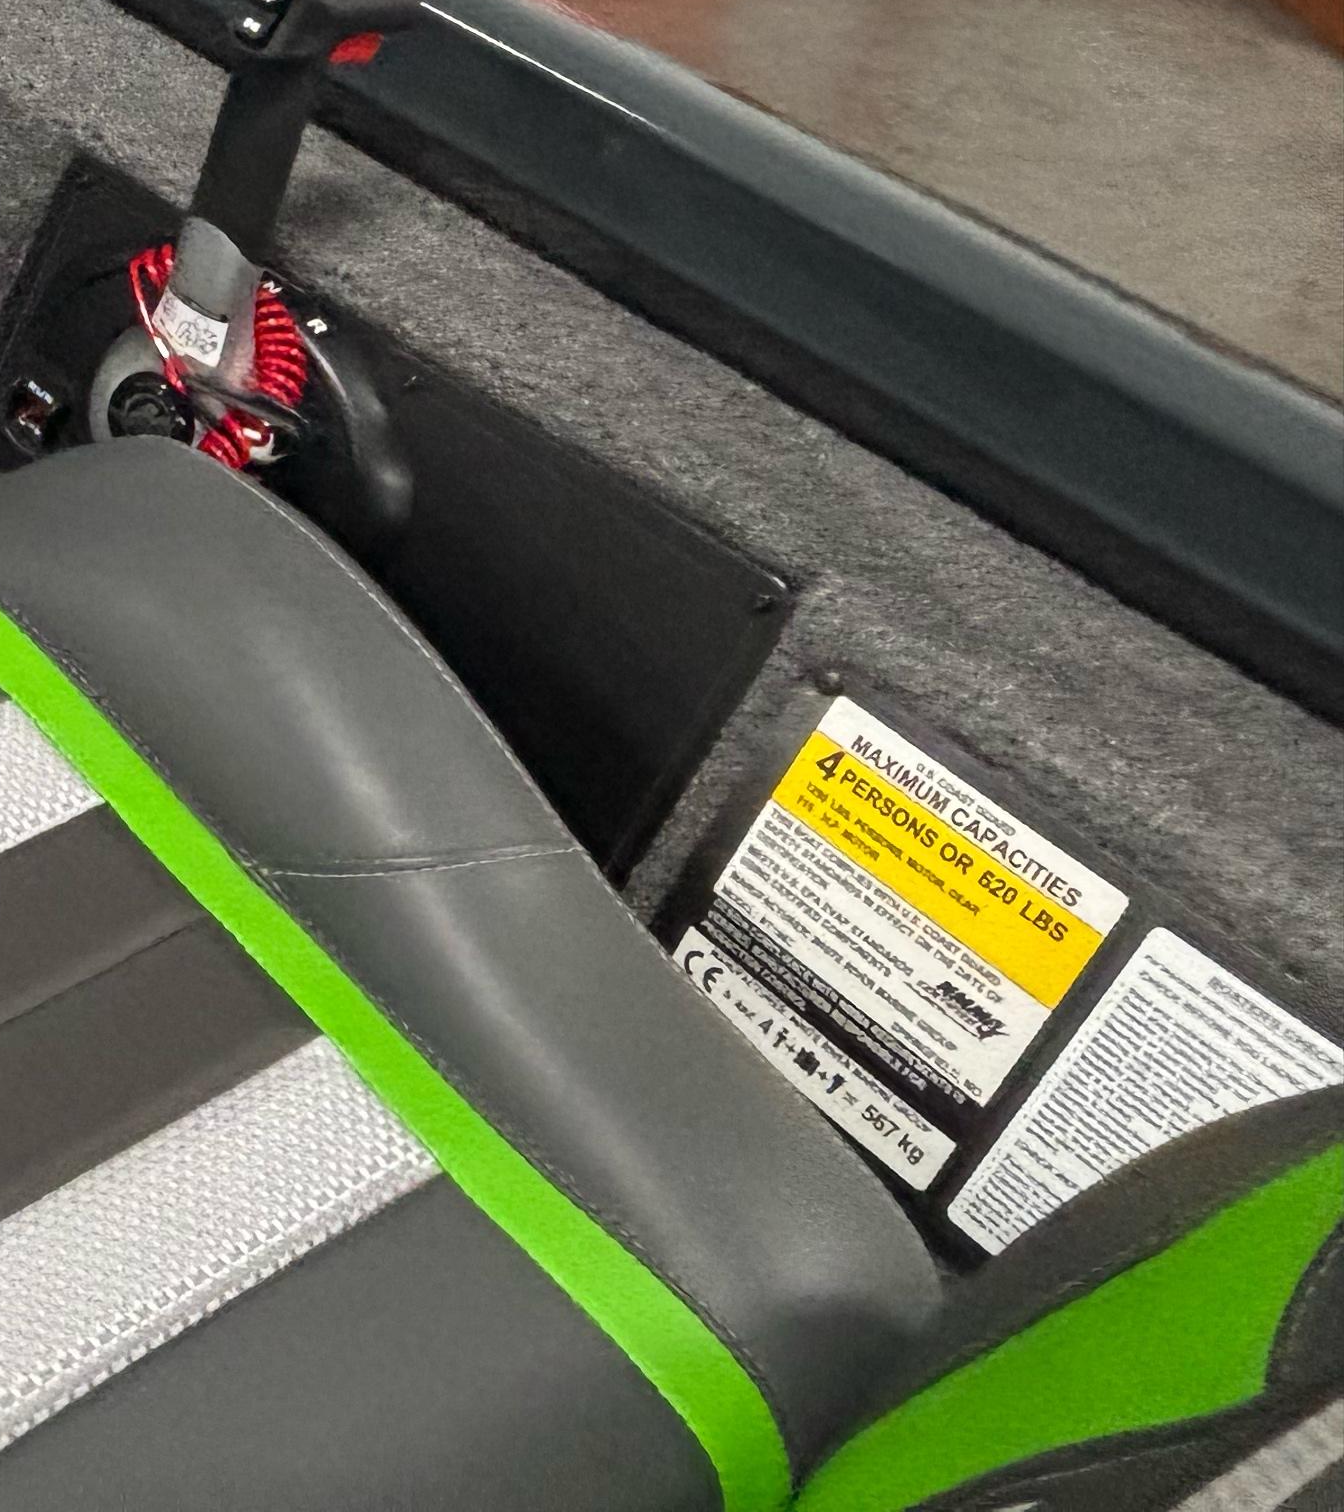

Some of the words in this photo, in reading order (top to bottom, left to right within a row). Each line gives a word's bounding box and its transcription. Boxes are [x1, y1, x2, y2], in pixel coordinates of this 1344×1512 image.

[815, 750, 846, 782] 4
[839, 768, 940, 849] PERSONS
[939, 842, 975, 876] OR
[1018, 899, 1069, 943] LBS
[850, 734, 952, 815] MAXIMUM
[950, 807, 1083, 908] CAPACITIES
